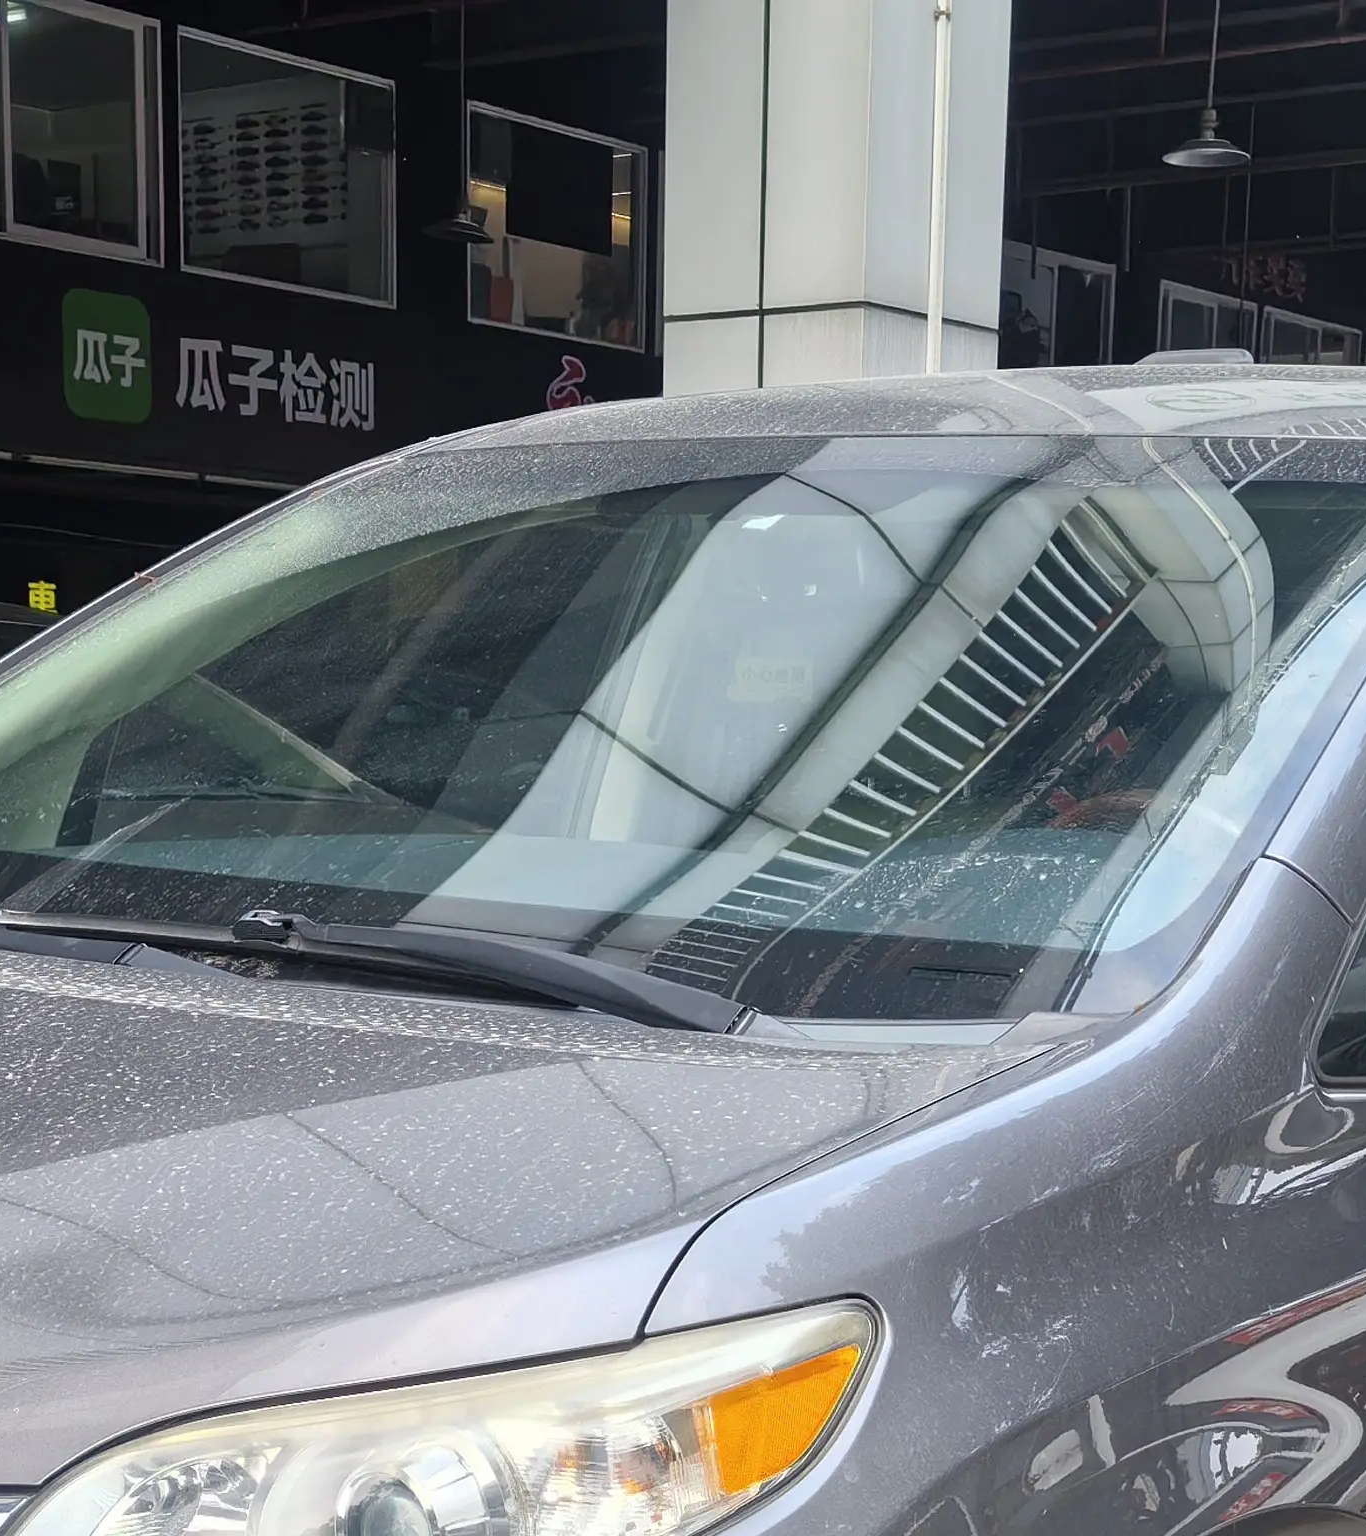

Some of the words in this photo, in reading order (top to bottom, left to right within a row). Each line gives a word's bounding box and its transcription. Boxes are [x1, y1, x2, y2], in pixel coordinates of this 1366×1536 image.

[72, 329, 146, 388] 瓜子
[176, 337, 375, 431] 瓜子检测
